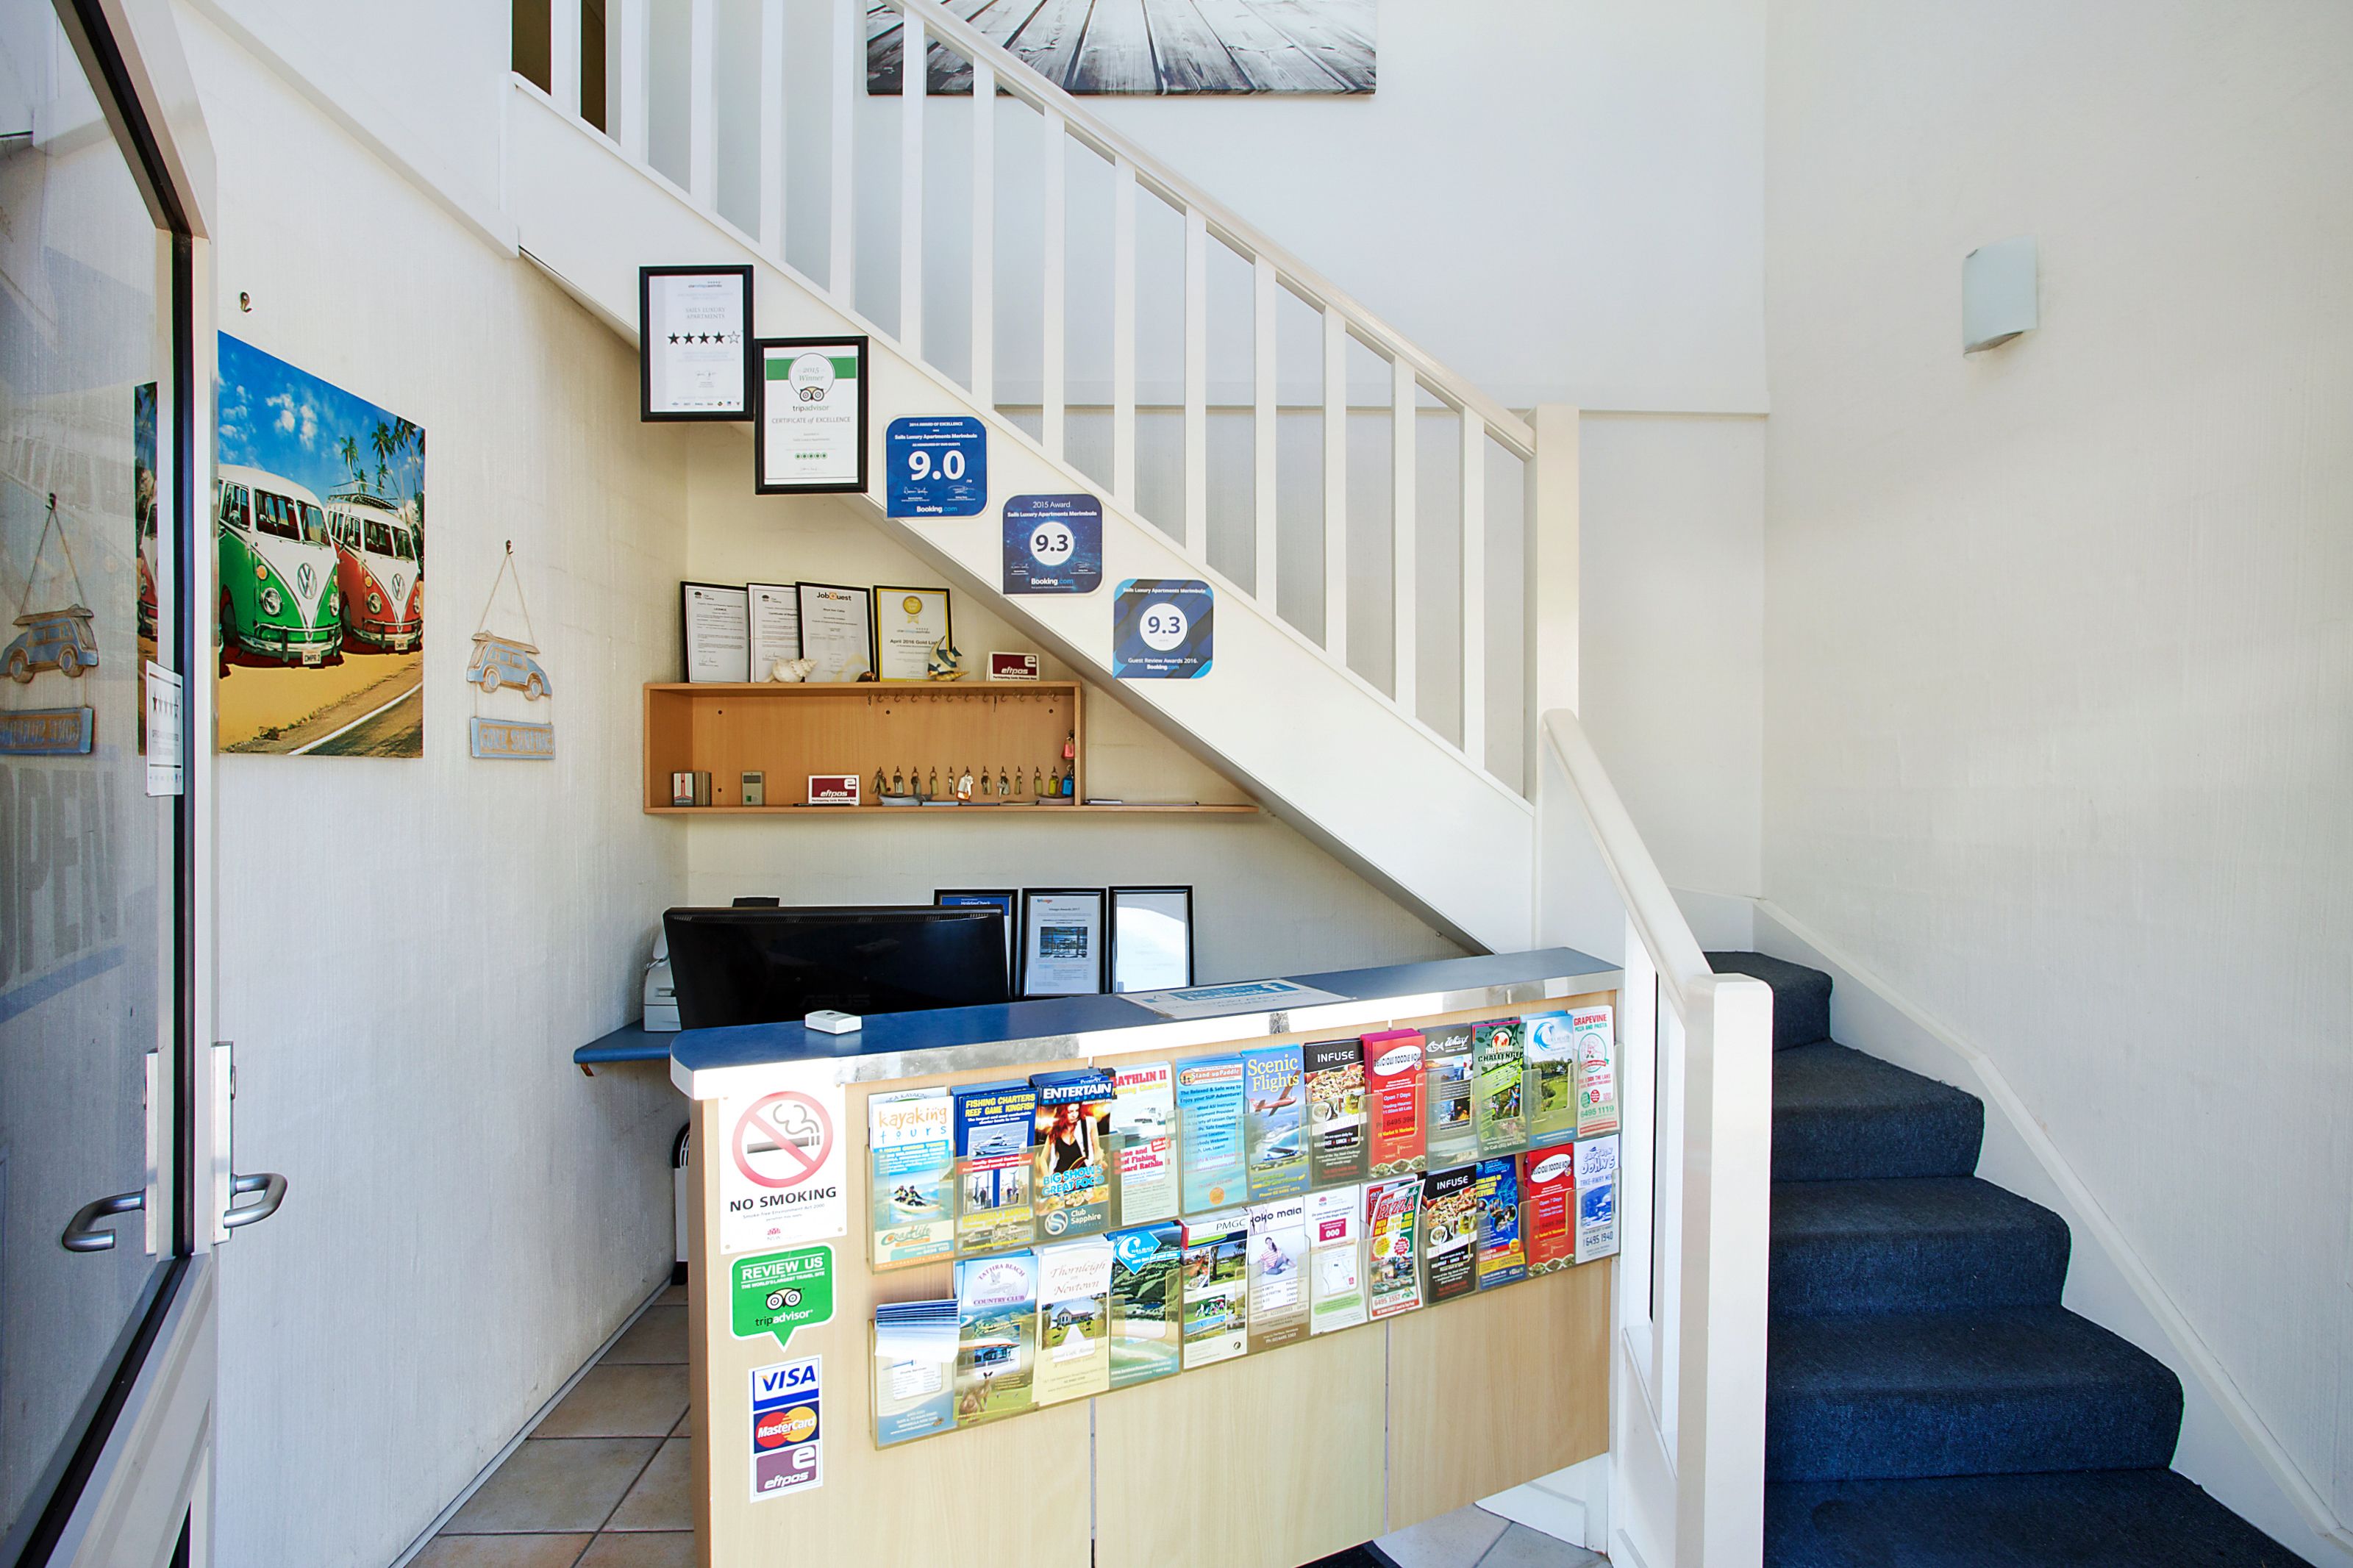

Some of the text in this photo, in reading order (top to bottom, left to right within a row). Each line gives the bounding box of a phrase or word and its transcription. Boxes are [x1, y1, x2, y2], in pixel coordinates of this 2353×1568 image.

[793, 404, 829, 413] tripadvisor
[807, 417, 814, 425] of
[908, 450, 965, 481] 9.0
[1035, 534, 1068, 553] 9.3
[1031, 577, 1074, 586] Booking.com
[816, 591, 852, 601] JobQuest
[1148, 616, 1180, 634] 9.3
[1001, 666, 1028, 676] eftpos
[480, 728, 551, 753] GONE SURFING
[820, 789, 848, 798] eftpos
[1186, 989, 1267, 1000] facebook
[1574, 1014, 1607, 1026] GRAPEVINE
[1444, 1034, 1469, 1048] Wharf
[1497, 1045, 1513, 1053] CLIMB
[1317, 1050, 1354, 1063] INFUSE
[1477, 1051, 1524, 1063] CHALLENGE
[1247, 1053, 1299, 1077] Scenic
[1159, 1069, 1167, 1081] II
[1252, 1072, 1300, 1093] Flights
[1043, 1082, 1112, 1100] ENTERTAIN
[1215, 1090, 1242, 1098] Adventure!
[965, 1093, 1035, 1109] FISHING CHARTERS
[1043, 1093, 1111, 1104] MERIMBULA
[965, 1102, 1035, 1117] REEF GAME KINGFISH
[1598, 1105, 1615, 1114] 1119
[879, 1106, 947, 1130] kayaking
[1386, 1117, 1402, 1127] 6495
[880, 1125, 947, 1145] tours
[1135, 1146, 1148, 1155] and
[1132, 1154, 1157, 1164] Fishing
[1139, 1160, 1163, 1170] Rathlin
[1043, 1164, 1103, 1186] BIG SHOWS
[1041, 1181, 1074, 1196] GREAT
[1436, 1175, 1469, 1191] INFUSE
[730, 1186, 837, 1212] NO SMOKING
[772, 1206, 803, 1216] Environment
[1071, 1208, 1087, 1217] Club
[1277, 1206, 1302, 1218] maia
[1377, 1195, 1415, 1220] PIZZA
[1071, 1213, 1101, 1225] Sapphire
[1215, 1217, 1247, 1232] PMGC
[1325, 1228, 1340, 1238] 000
[1585, 1231, 1613, 1247] 6495 1940
[742, 1256, 824, 1281] REVIEW US
[1005, 1263, 1026, 1278] BEACH
[1050, 1259, 1108, 1278] Thornleigh
[751, 1280, 773, 1288] WORLD'S
[773, 1276, 796, 1285] LARGEST
[1054, 1280, 1100, 1296] Newtown
[973, 1296, 1006, 1306] COUNTRY
[755, 1309, 813, 1327] tripadvisor
[759, 1364, 816, 1392] VISA
[757, 1416, 816, 1439] MasterCard
[764, 1471, 810, 1489] eftpos
